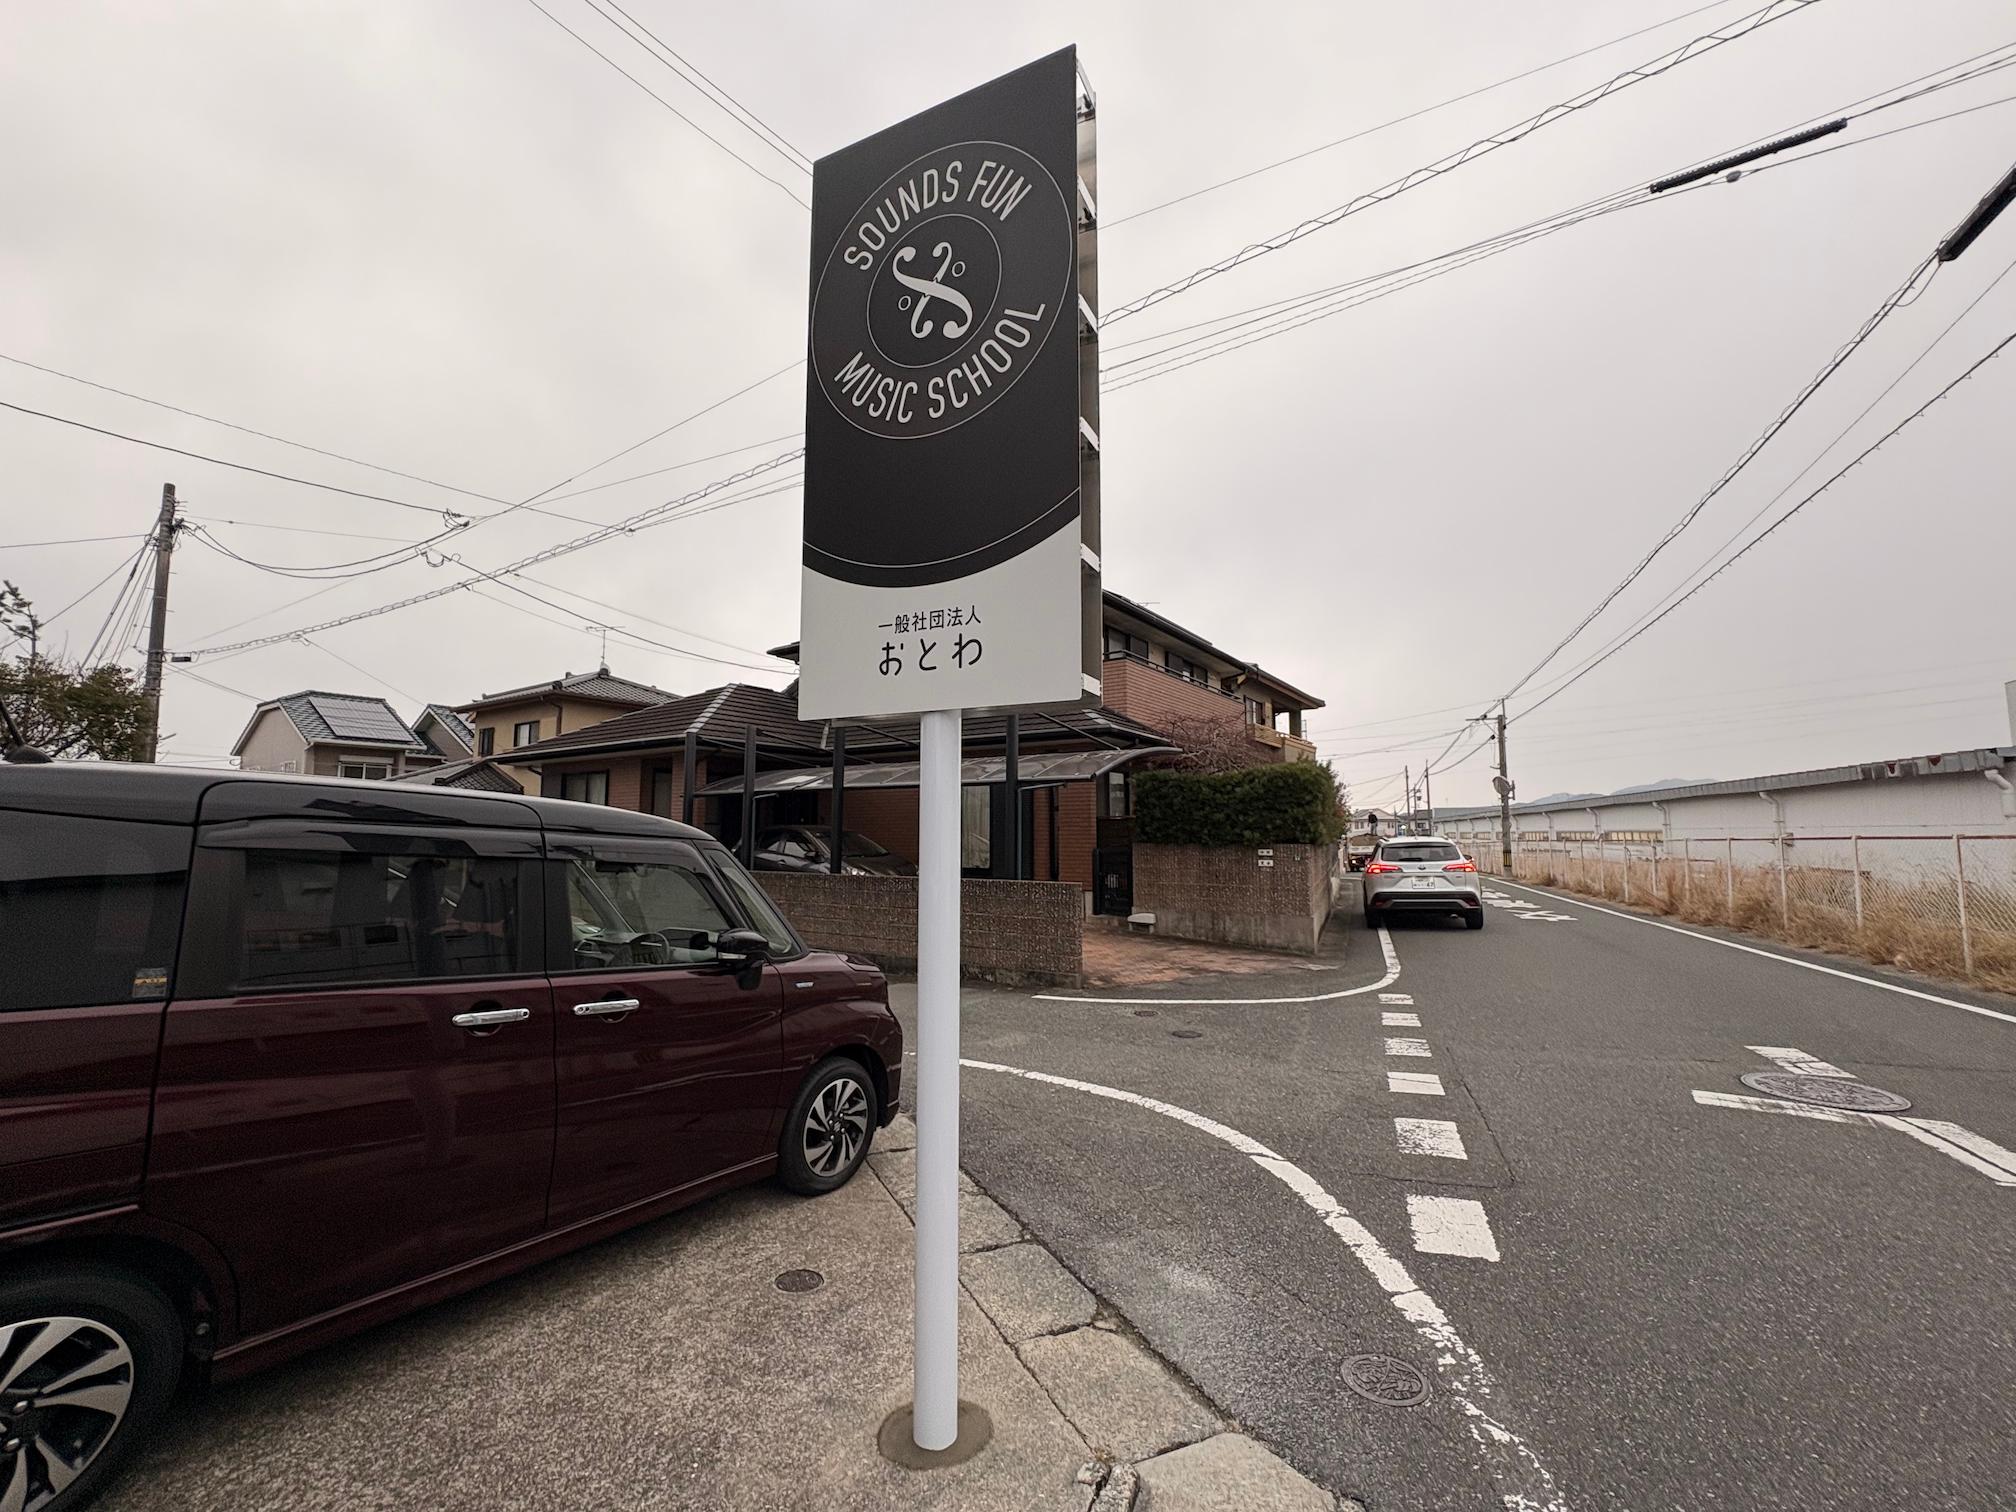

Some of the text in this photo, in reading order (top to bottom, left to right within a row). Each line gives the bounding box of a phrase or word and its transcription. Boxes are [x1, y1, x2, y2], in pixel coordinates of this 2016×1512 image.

[844, 160, 1032, 271] SOUNDS FUN
[834, 303, 1046, 424] MUSIC SCHOOL
[878, 604, 981, 634] 一般社団法人
[879, 633, 982, 676] おとわ
